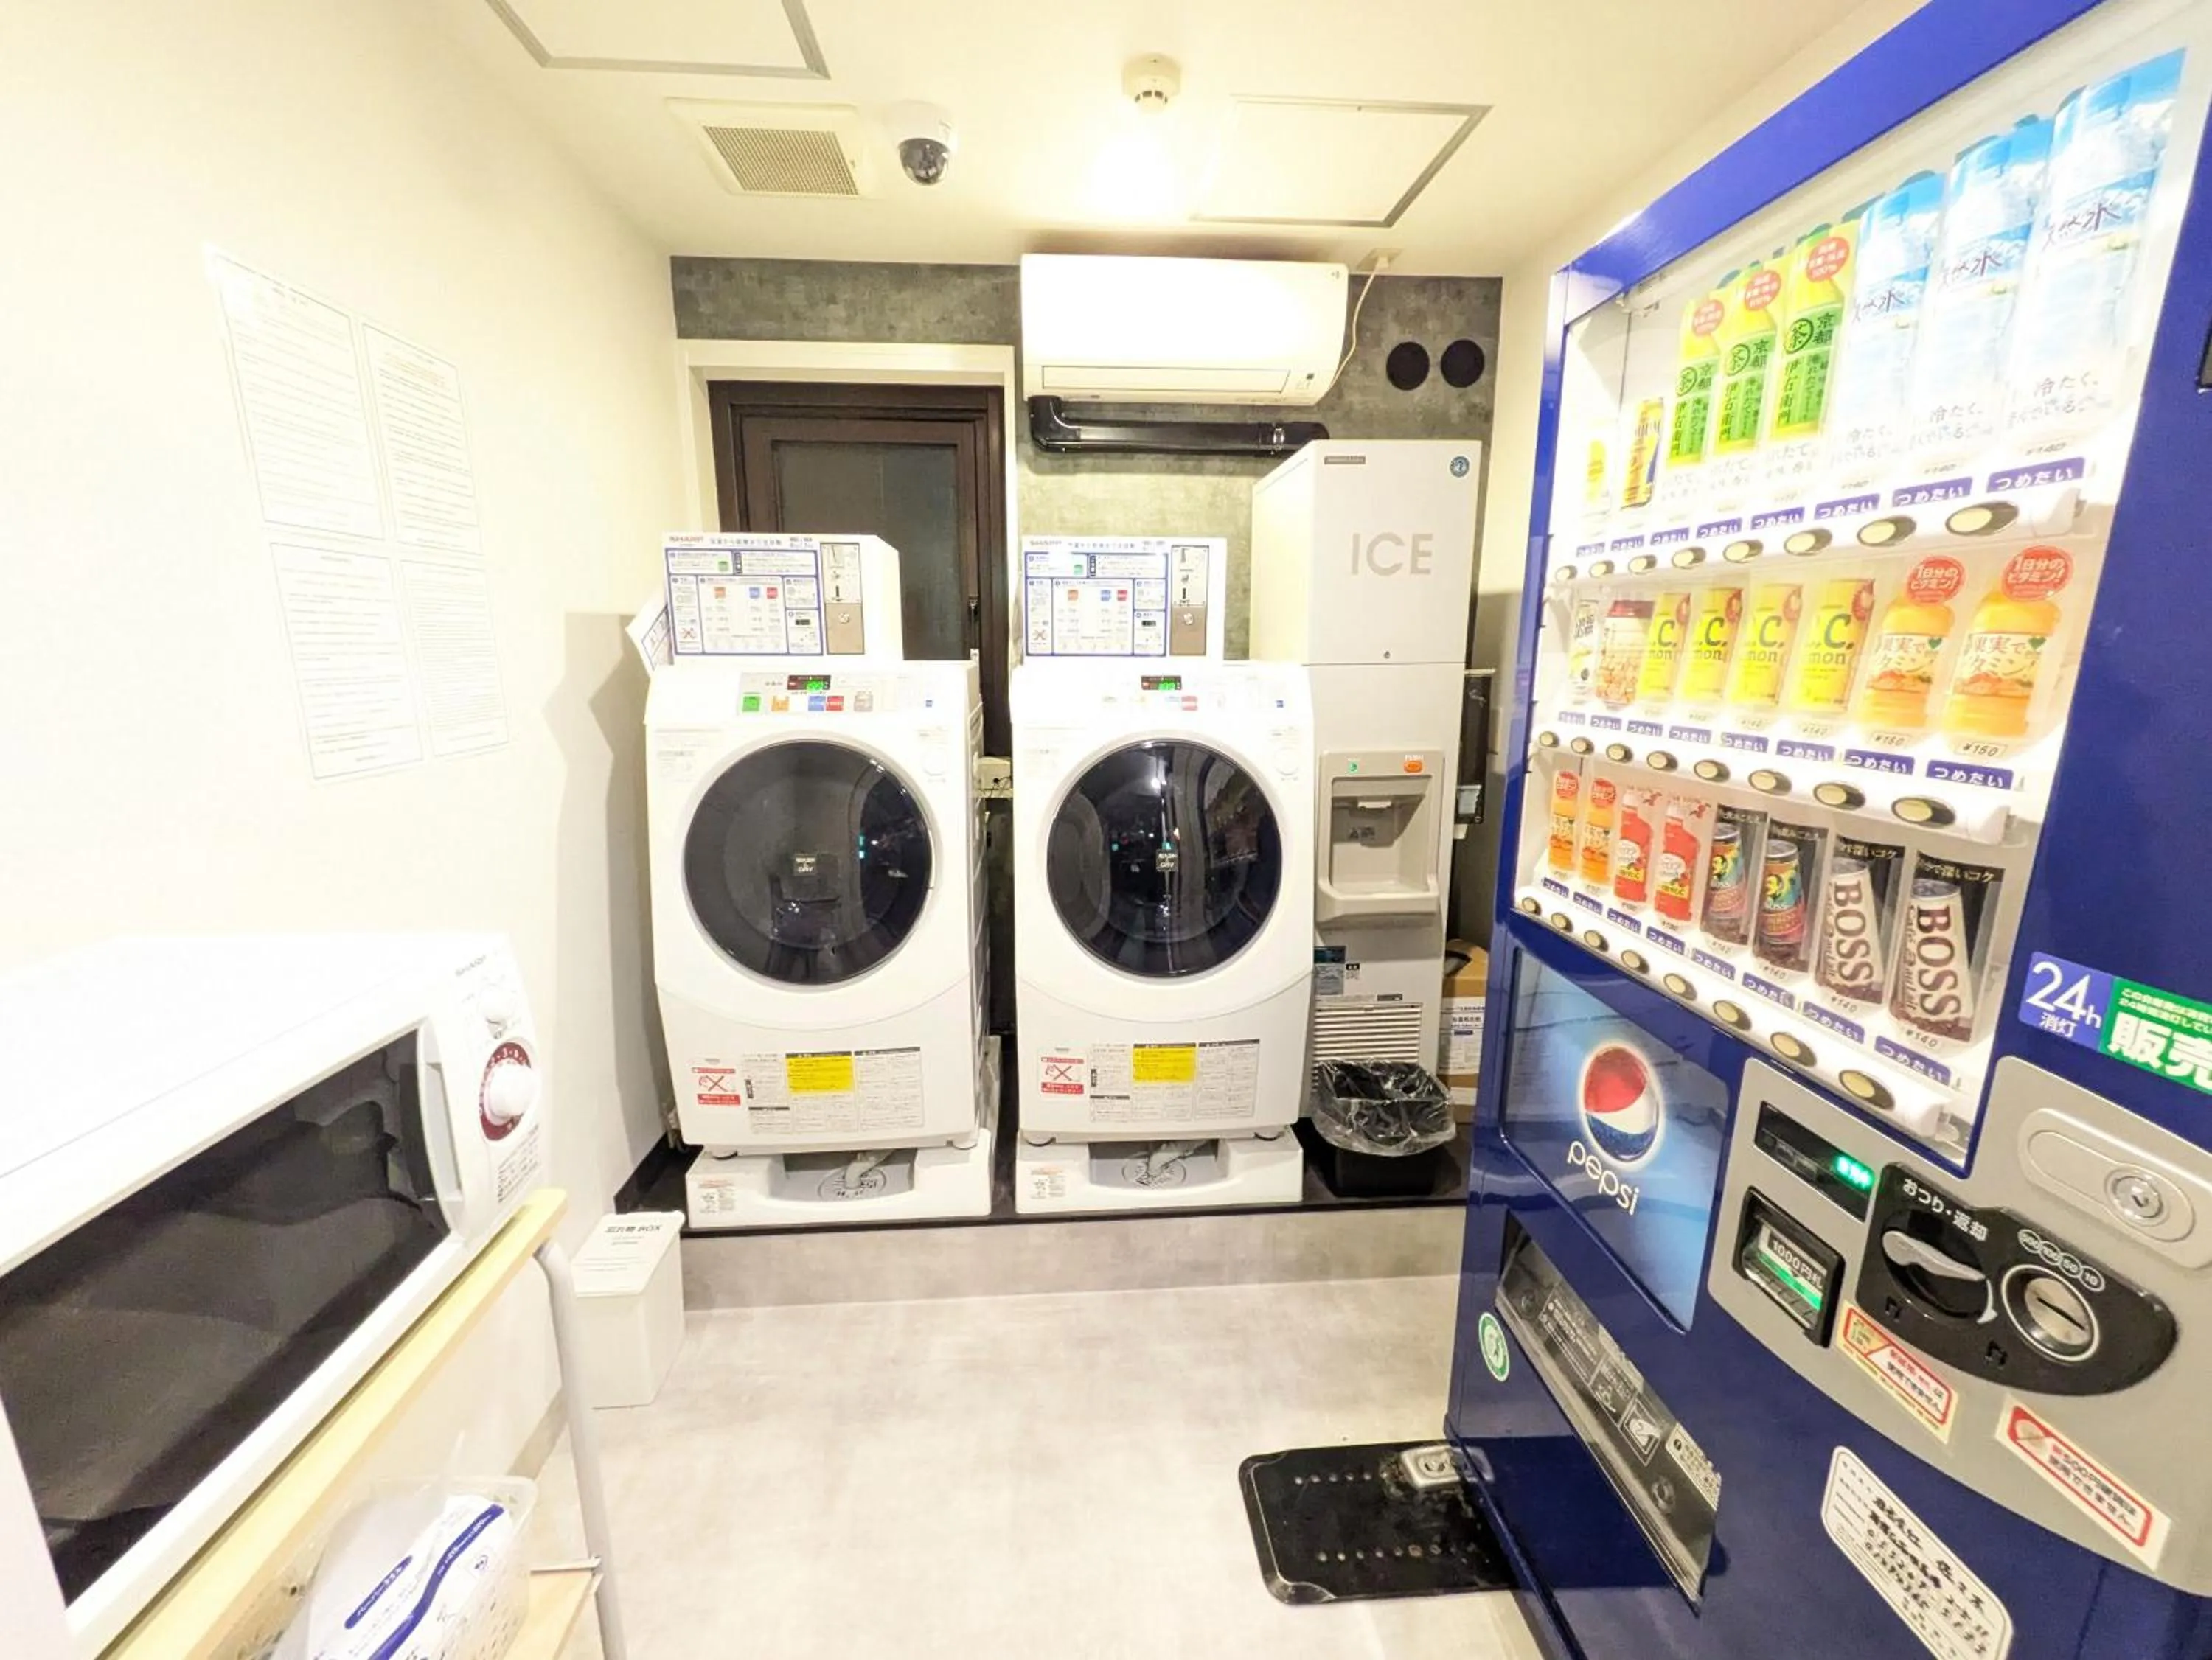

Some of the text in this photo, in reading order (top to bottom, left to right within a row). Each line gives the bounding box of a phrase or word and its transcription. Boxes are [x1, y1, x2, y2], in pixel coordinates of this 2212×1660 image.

[1812, 312, 1834, 343] 京都
[1995, 467, 2074, 490] つめたい
[1896, 484, 1964, 506] つめたい
[1755, 512, 1800, 529] つめたい
[1818, 500, 1874, 518] つめたい
[1351, 532, 1433, 576] ICE
[2014, 555, 2065, 572] 1日分の
[1917, 565, 1960, 579] 1日分の
[1723, 736, 1764, 752] つめたい
[1781, 745, 1829, 762] つめたい
[1846, 755, 1907, 774] つめたい
[1934, 767, 2003, 788] つめたい
[1649, 929, 1684, 953] つめたい
[1834, 879, 1874, 982] BOSS
[1695, 954, 1732, 979] つめたい
[1917, 904, 1961, 1016] BOSS
[1745, 977, 1793, 1005] つめたい
[2026, 961, 2101, 1029] 24h
[1831, 996, 1857, 1014] ¥140
[1808, 1008, 1860, 1040] つめたい
[2039, 1012, 2077, 1038] 消灯
[1905, 1029, 1938, 1047] ¥140
[1881, 1044, 1944, 1082] つめたい
[2107, 1011, 2212, 1091] 販売
[1567, 1140, 1639, 1215] pepsi
[1903, 1179, 1988, 1241] おつり・返却
[1772, 1240, 1823, 1289] 1000円札
